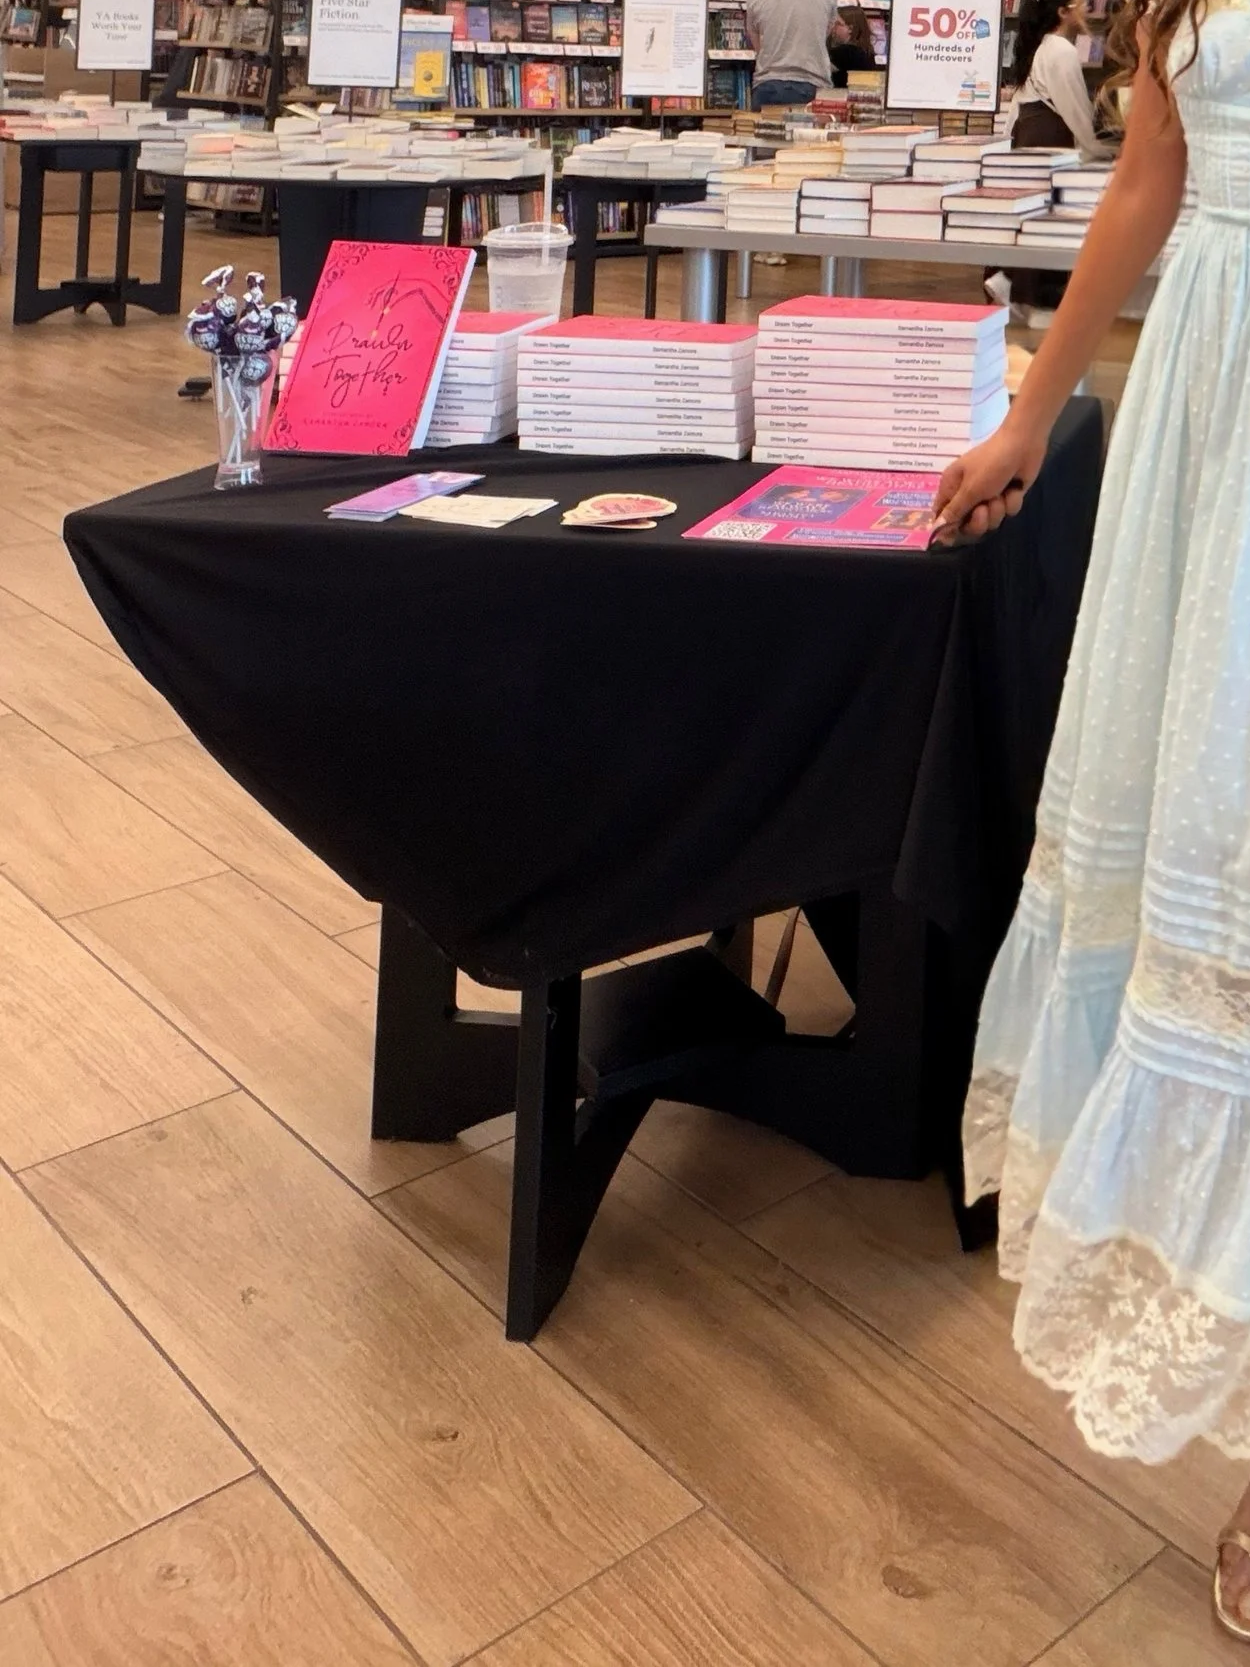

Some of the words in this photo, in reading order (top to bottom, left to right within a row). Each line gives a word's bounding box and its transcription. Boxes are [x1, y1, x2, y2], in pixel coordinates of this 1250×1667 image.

[113, 11, 139, 21] Books
[319, 8, 359, 20] Fiction
[92, 22, 118, 31] Worth
[122, 22, 143, 31] Your
[914, 43, 962, 53] Hundreds
[965, 43, 976, 53] of
[916, 53, 973, 63] Hardcovers
[792, 321, 813, 329] Together
[323, 321, 413, 355] Drawn
[312, 351, 408, 409] Together
[784, 453, 805, 461] Together
